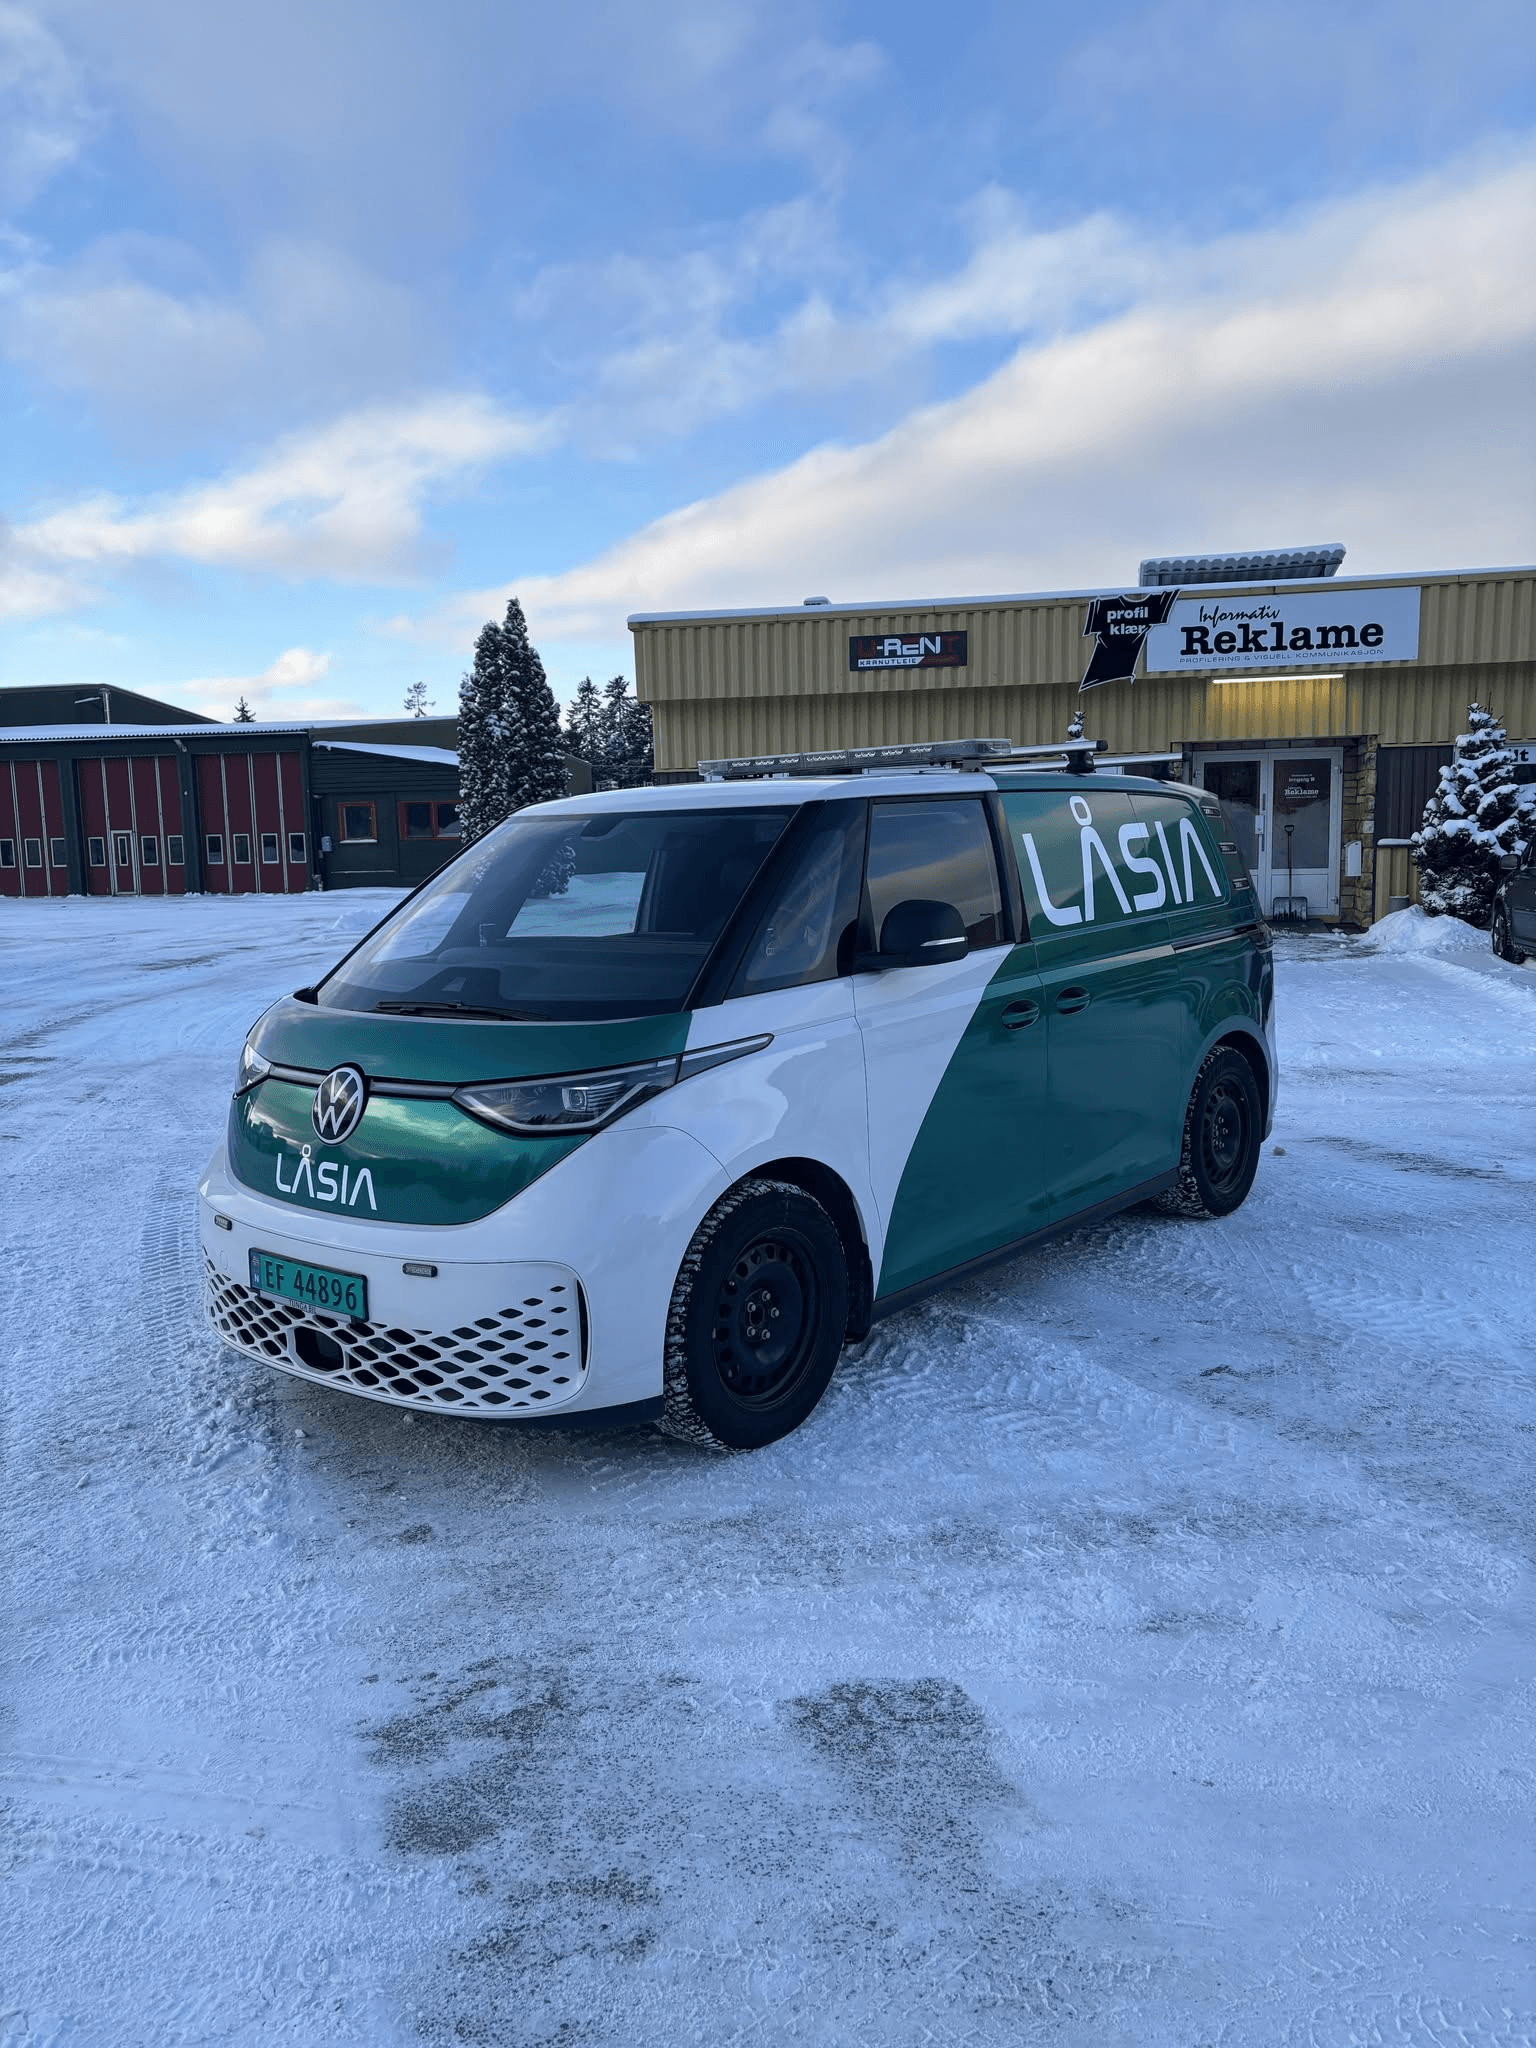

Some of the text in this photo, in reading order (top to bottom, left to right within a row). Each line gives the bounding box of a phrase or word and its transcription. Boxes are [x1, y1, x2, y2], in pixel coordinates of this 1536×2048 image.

[1106, 606, 1149, 623] profil
[1199, 605, 1280, 628] Informativ
[1109, 623, 1146, 635] klær
[1180, 622, 1384, 655] Reklame
[1179, 655, 1241, 664] PROFILERING
[1295, 649, 1384, 659] KOMMUNIKASJON
[1021, 795, 1222, 926] LÅSIA
[275, 1144, 377, 1211] LÅSIA
[264, 1259, 358, 1311] EF 44896
